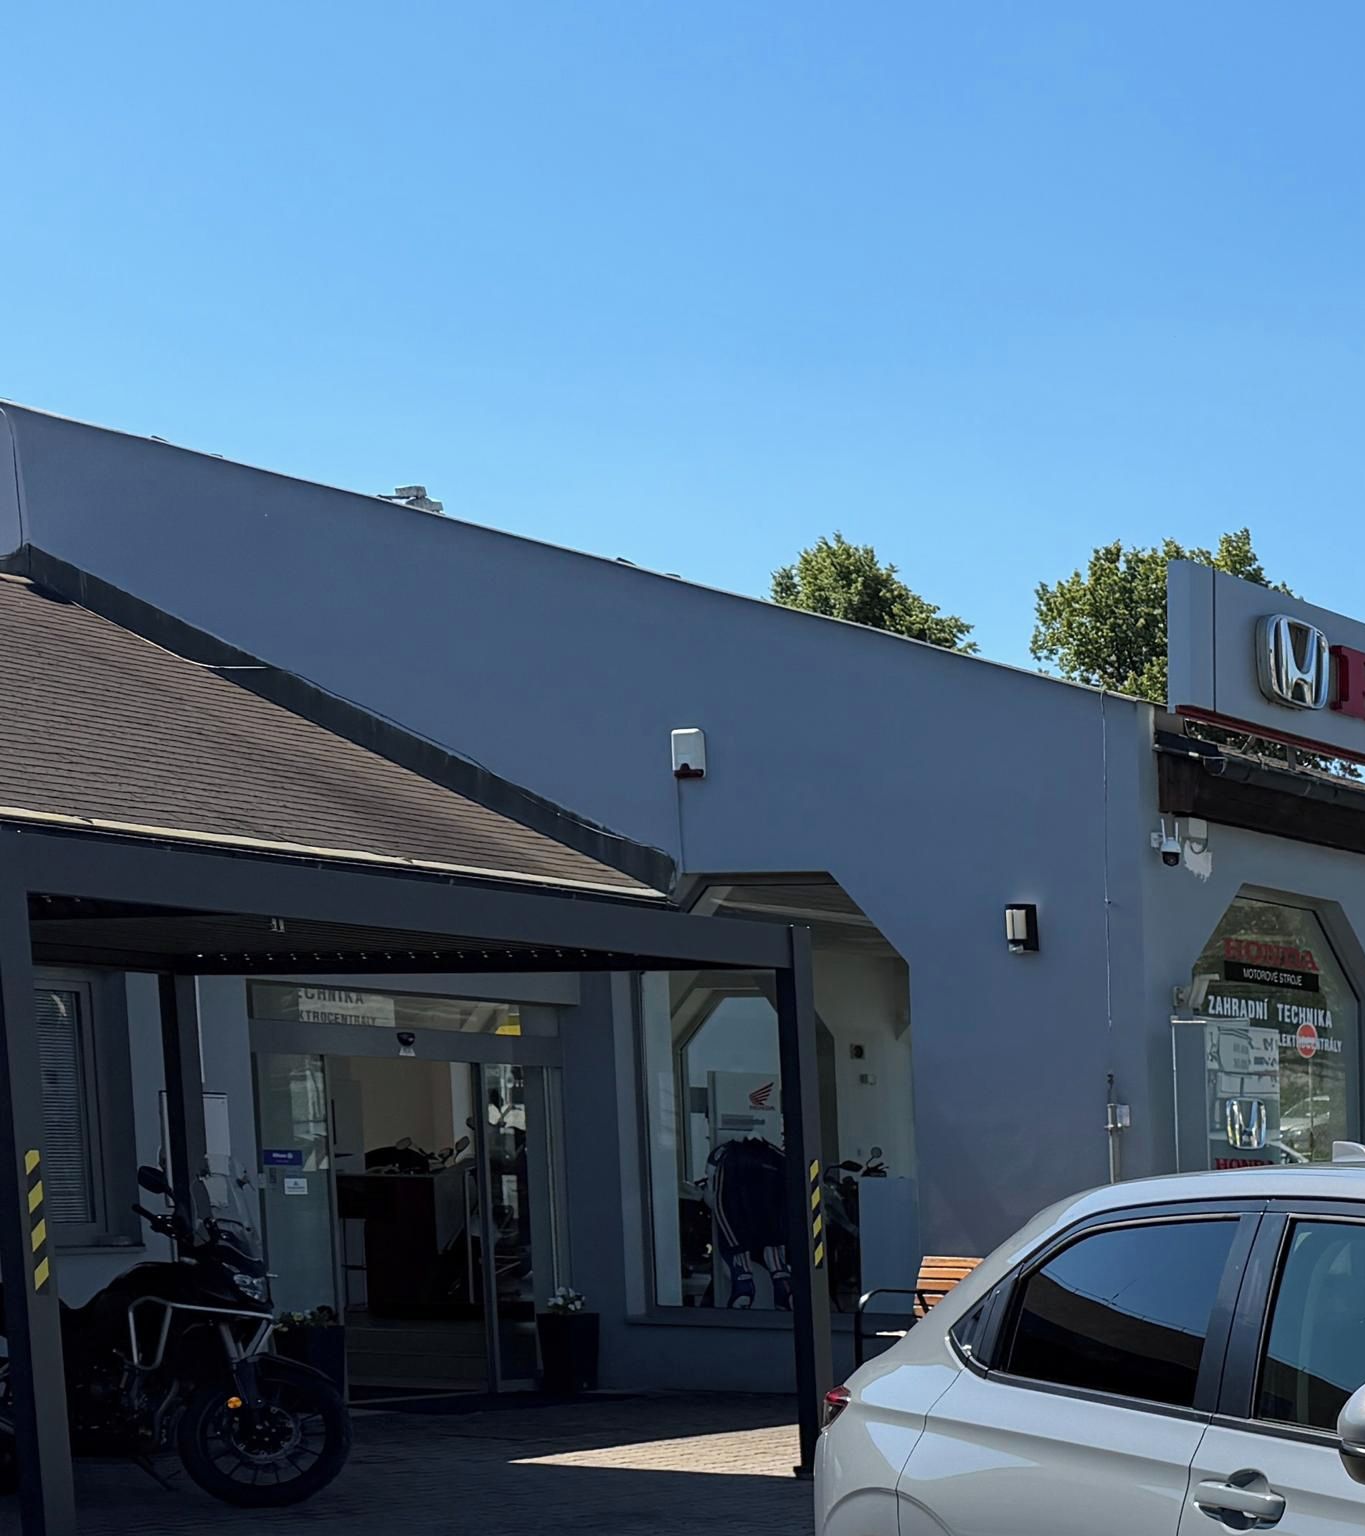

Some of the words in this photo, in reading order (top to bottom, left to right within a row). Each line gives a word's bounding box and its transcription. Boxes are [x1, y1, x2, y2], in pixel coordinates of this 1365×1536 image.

[1223, 937, 1319, 971] HONDA
[1208, 995, 1268, 1021] ZAHRADNÍ
[1276, 1003, 1333, 1028] TECHNIKA
